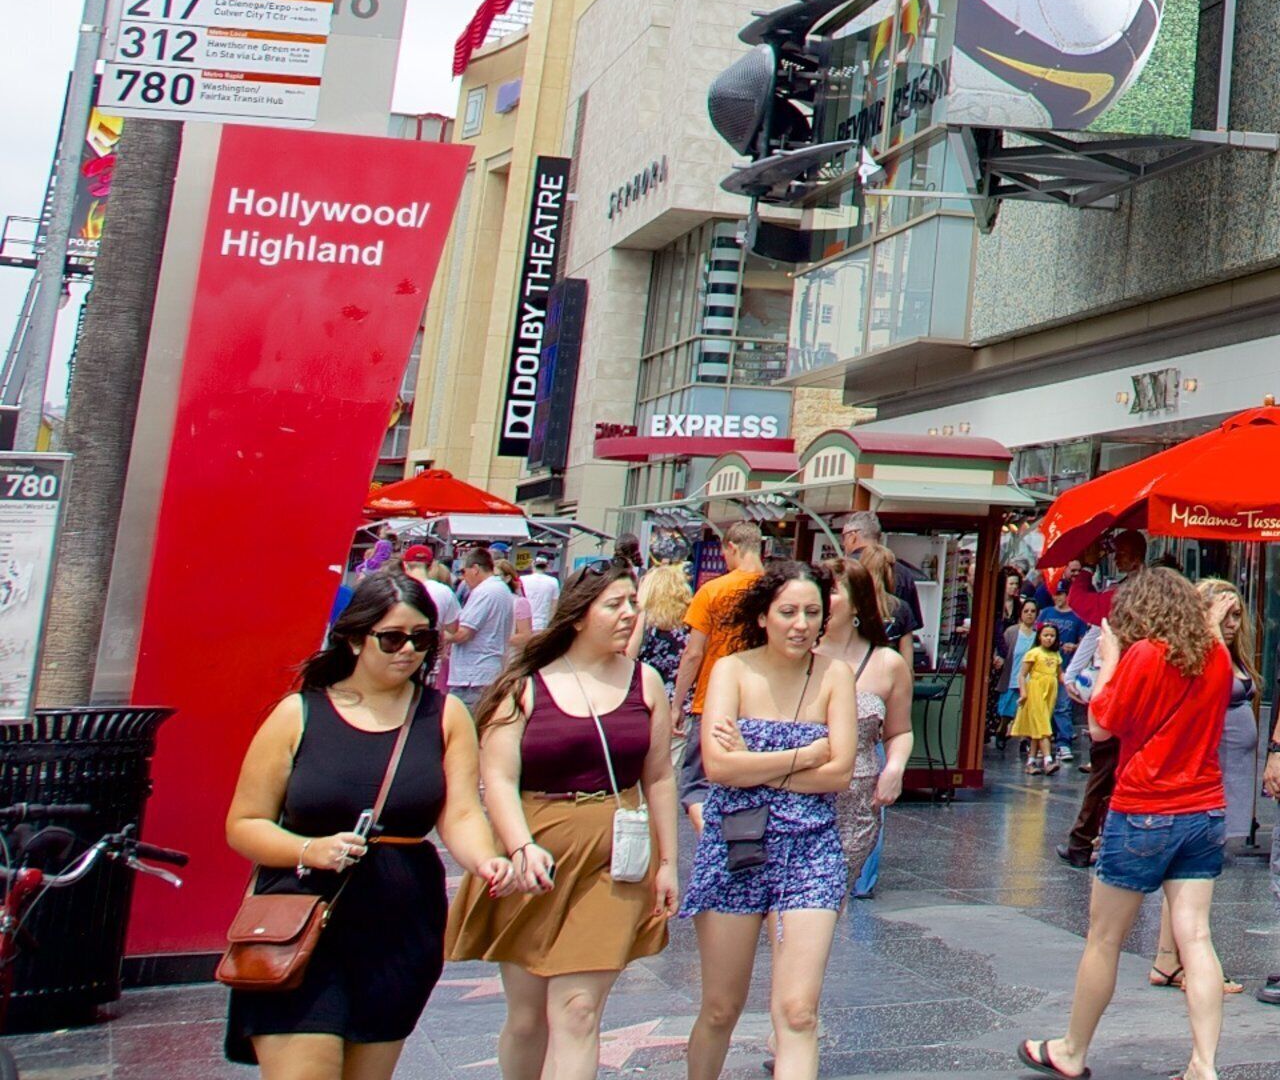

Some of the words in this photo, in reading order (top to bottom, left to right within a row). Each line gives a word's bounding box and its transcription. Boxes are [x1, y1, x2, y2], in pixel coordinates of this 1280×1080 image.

[214, 8, 244, 18] Culver
[246, 10, 264, 21] City
[273, 12, 288, 21] Ctr
[228, 0, 291, 12] Cienega/Expo
[120, 26, 197, 62] 312
[207, 39, 259, 51] Hawthorne
[261, 43, 289, 53] Green
[206, 50, 218, 58] Ln
[219, 50, 235, 59] Sta
[236, 52, 250, 60] via
[251, 53, 263, 61] La
[264, 54, 286, 63] Brea
[115, 69, 195, 105] 780
[200, 92, 231, 102] Fairfax
[233, 94, 265, 104] Transit
[266, 96, 284, 105] Hub
[202, 82, 261, 94] Washington/
[226, 186, 430, 228] Hollywood/
[220, 227, 385, 267] Highland
[526, 173, 564, 297] THEATRE
[512, 302, 547, 396] DOLBY
[650, 414, 778, 438] EXPRESS
[6, 474, 57, 497] 780
[1171, 503, 1242, 528] Madame
